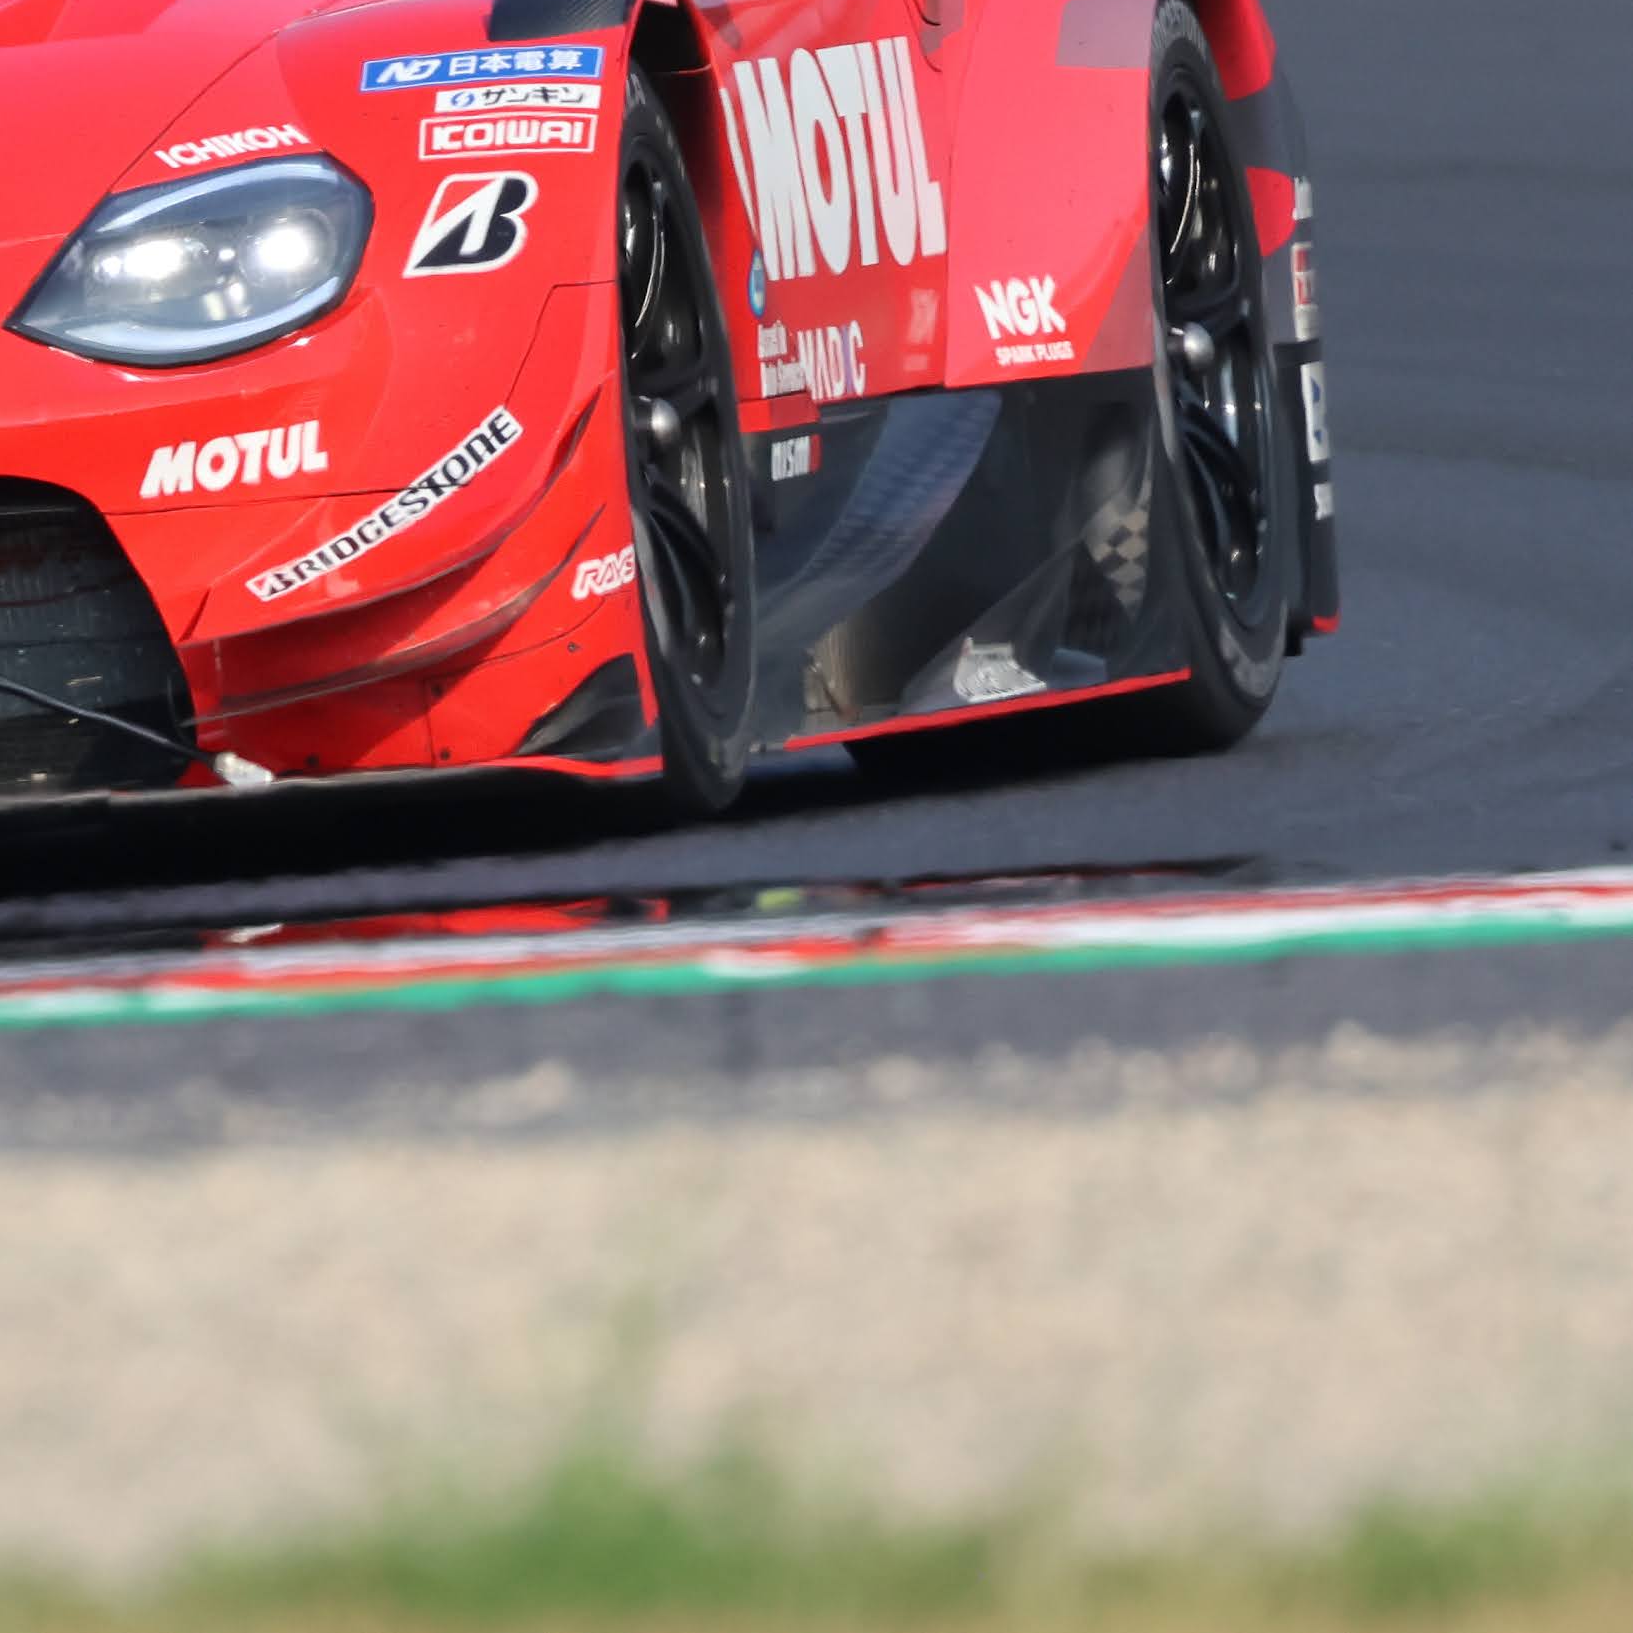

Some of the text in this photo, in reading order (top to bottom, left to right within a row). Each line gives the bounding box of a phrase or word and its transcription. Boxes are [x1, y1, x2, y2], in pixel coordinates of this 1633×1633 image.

[449, 50, 583, 77] 日本電算
[483, 85, 586, 108] サンキン
[155, 124, 310, 168] ICHIKOH
[733, 36, 947, 281] MOTUL
[974, 274, 1067, 340] NGK
[140, 420, 329, 499] MOTUL
[255, 410, 517, 599] BRIDGESTONE
